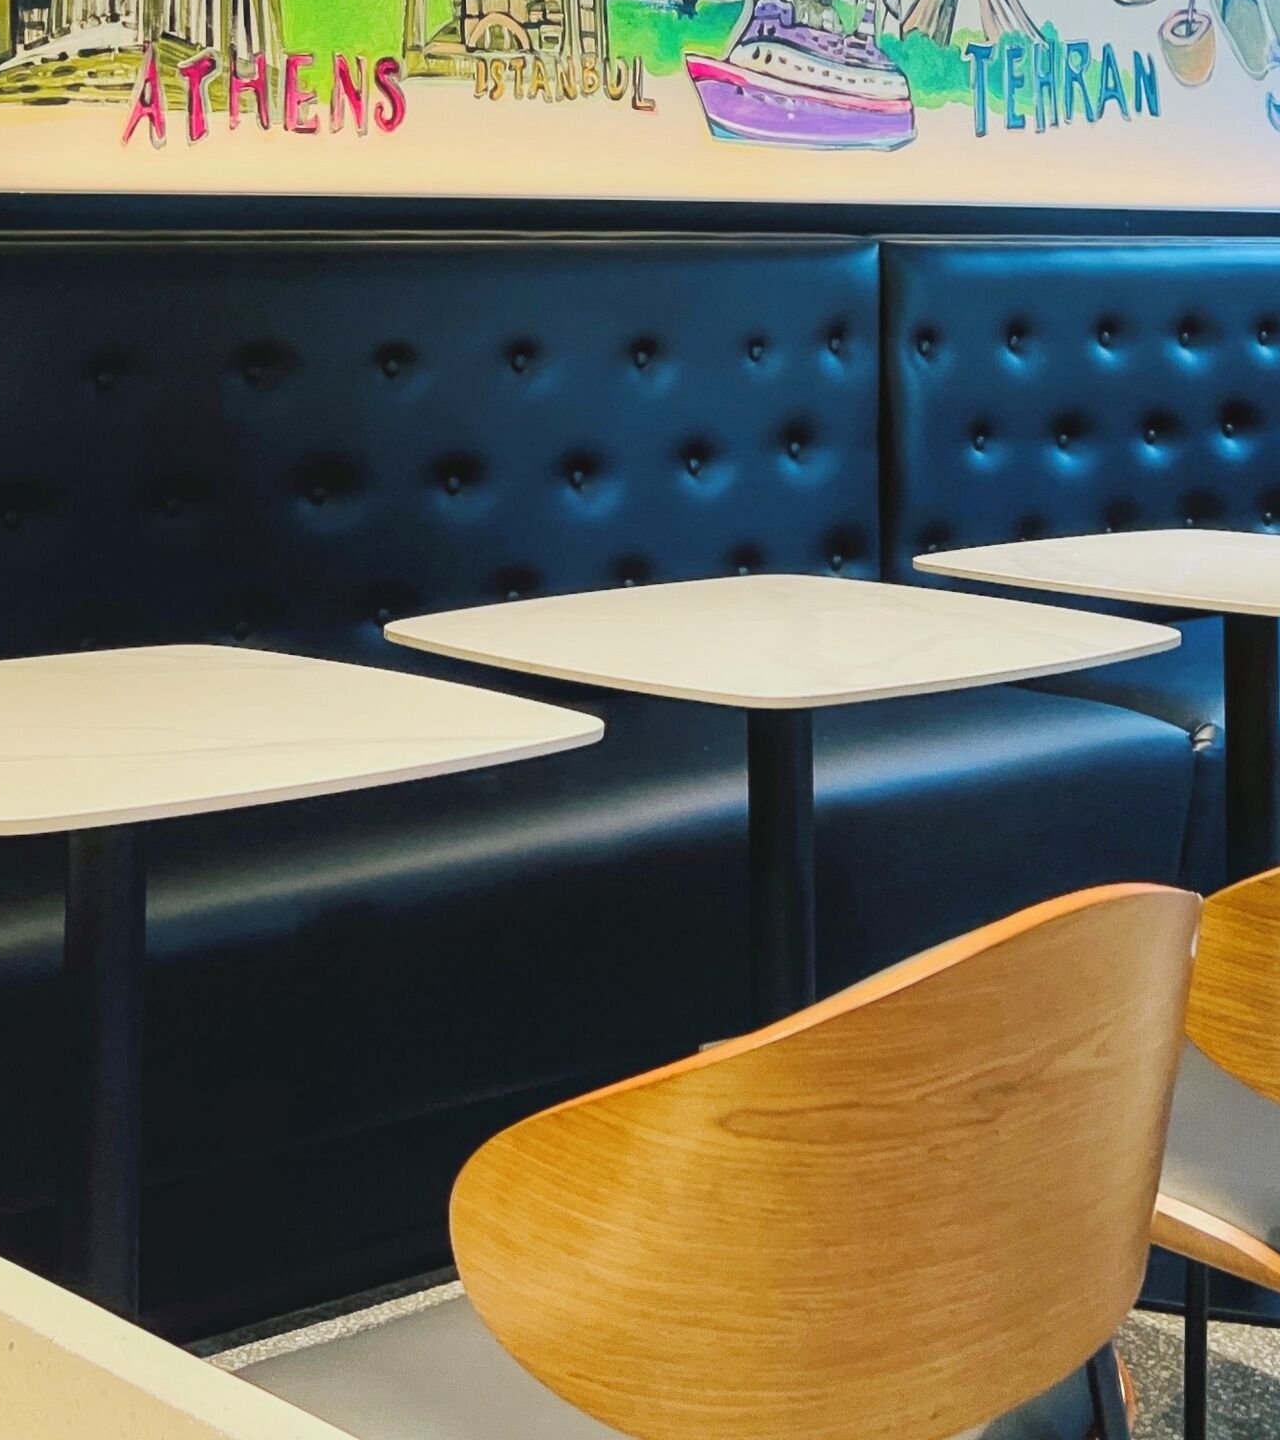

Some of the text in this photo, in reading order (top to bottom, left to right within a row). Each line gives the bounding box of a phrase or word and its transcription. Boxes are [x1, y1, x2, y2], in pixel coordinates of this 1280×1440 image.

[122, 45, 408, 149] ATHENS
[472, 50, 657, 113] ISTANBUL
[964, 40, 1162, 138] TEHRAN
